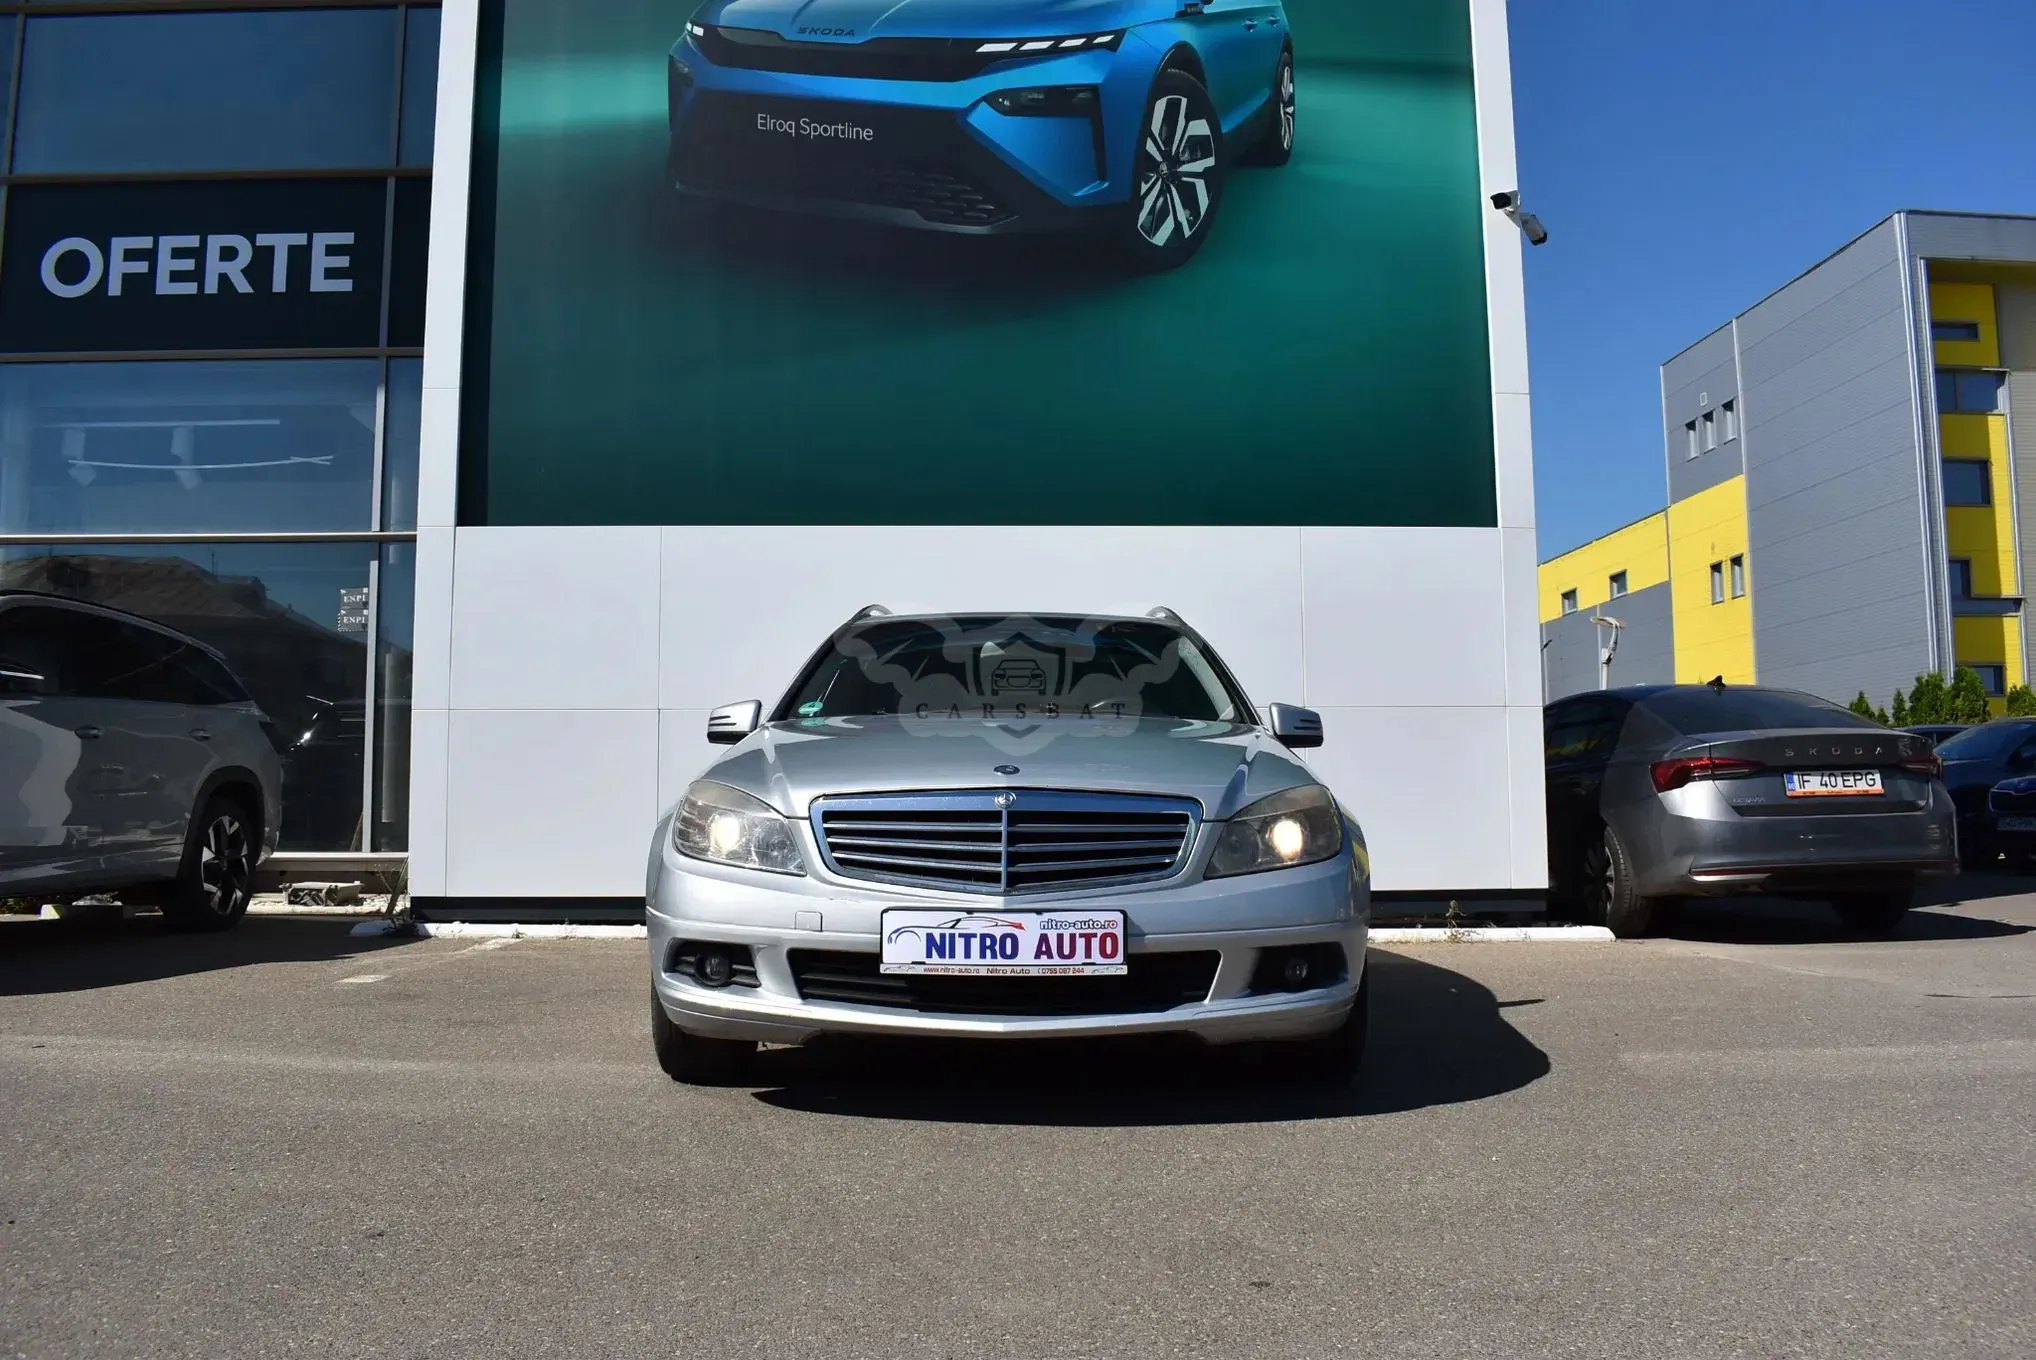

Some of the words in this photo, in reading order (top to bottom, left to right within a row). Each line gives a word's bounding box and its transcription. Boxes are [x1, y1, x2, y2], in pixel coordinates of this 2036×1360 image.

[757, 113, 796, 138] Elroq
[799, 118, 874, 141] Sportline
[40, 231, 355, 298] OFERTE
[1797, 773, 1811, 789] IF
[1819, 772, 1838, 788] 40
[1841, 771, 1877, 788] EPG
[1039, 918, 1118, 930] nitro-auto.ro
[925, 931, 1019, 960] NITRO
[1033, 931, 1119, 960] AUTO
[986, 967, 1008, 975] Nitro
[1009, 967, 1031, 975] Auto
